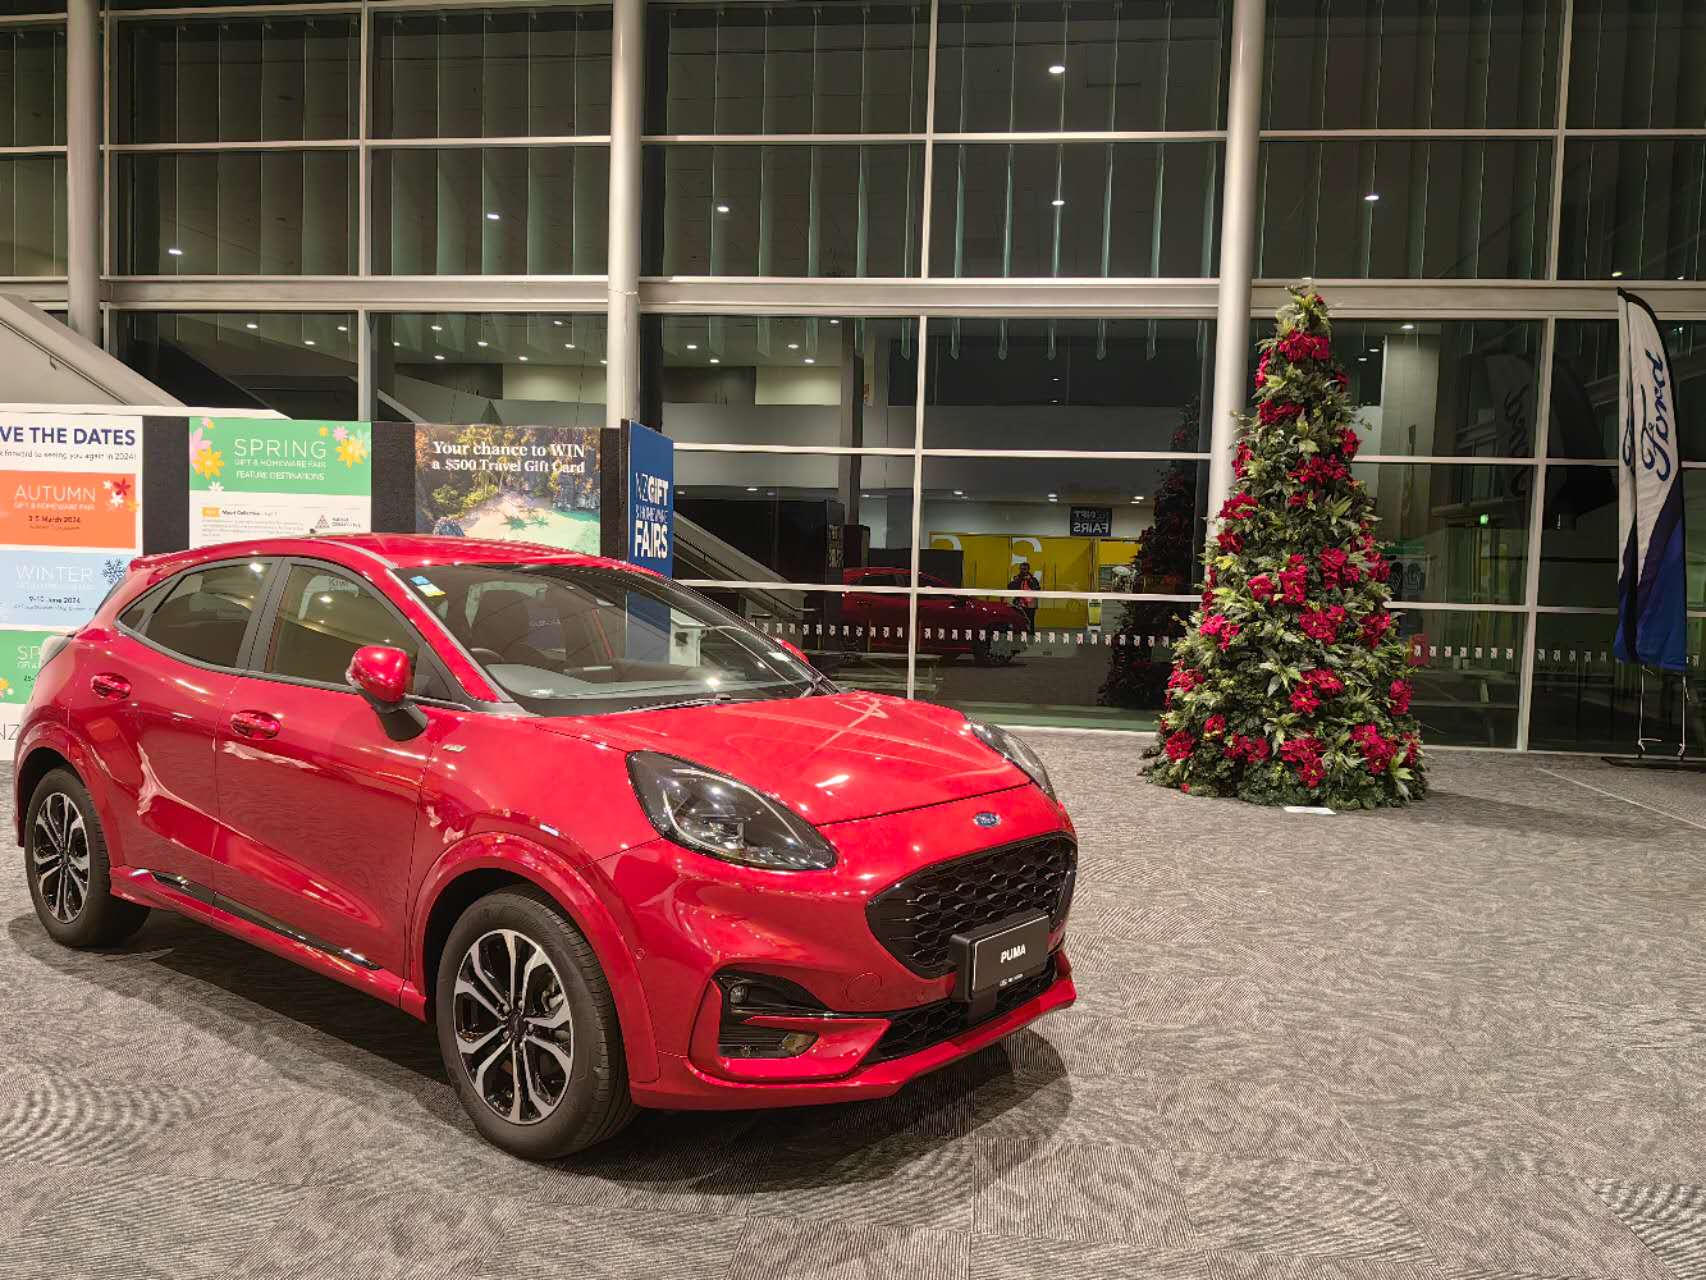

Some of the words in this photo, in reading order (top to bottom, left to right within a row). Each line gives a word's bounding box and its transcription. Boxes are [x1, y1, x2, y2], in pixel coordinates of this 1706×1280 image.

[1640, 348, 1671, 481] Ford
[0, 426, 24, 442] VE
[29, 427, 67, 444] THE
[74, 428, 136, 446] DATES
[234, 438, 326, 459] SPRING
[433, 441, 470, 456] Your
[473, 441, 529, 457] chance
[531, 444, 547, 457] to
[549, 443, 586, 458] WIN
[236, 470, 268, 480] FEATURE
[269, 471, 325, 481] DESTINATIONS
[432, 461, 440, 469] a
[445, 458, 477, 471] $500
[479, 458, 522, 472] Travel
[524, 459, 549, 472] Gift
[552, 460, 586, 474] Card
[15, 485, 96, 502] AUTUMN
[634, 520, 668, 559] FAIRS
[15, 566, 95, 584] WINTER
[1000, 944, 1026, 964] PUMA
